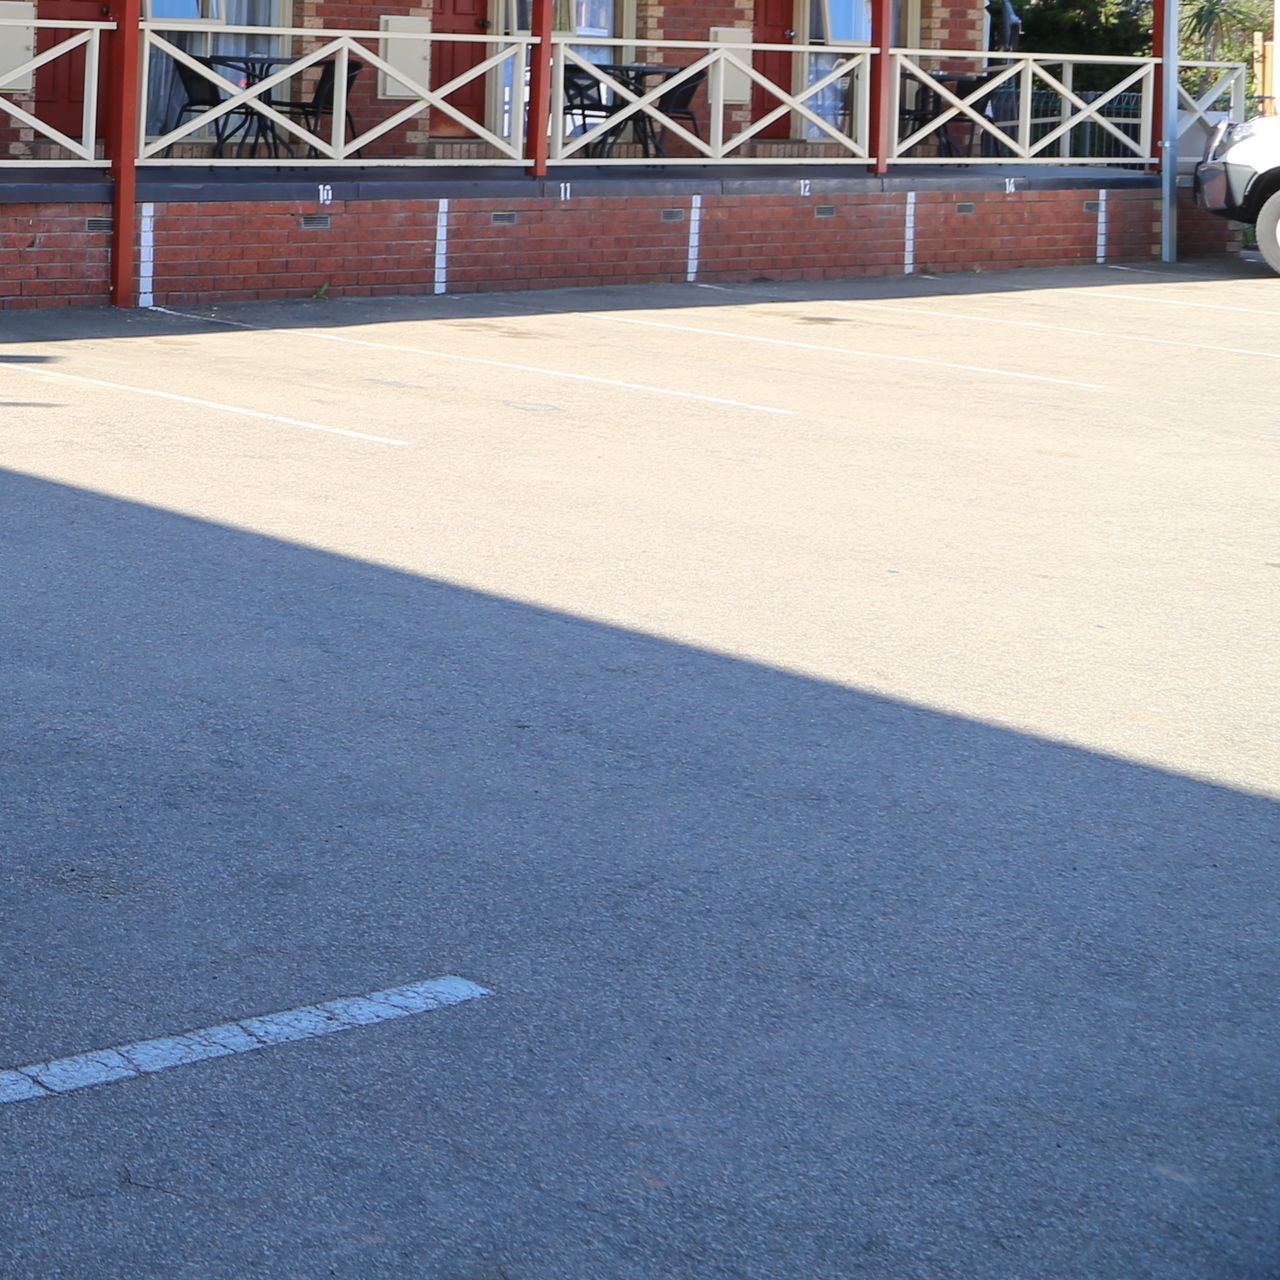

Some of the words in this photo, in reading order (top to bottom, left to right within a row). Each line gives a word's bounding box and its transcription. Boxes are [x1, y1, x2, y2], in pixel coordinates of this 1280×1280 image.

[318, 184, 332, 204] 10
[560, 182, 570, 200] 11
[800, 179, 810, 196] 12
